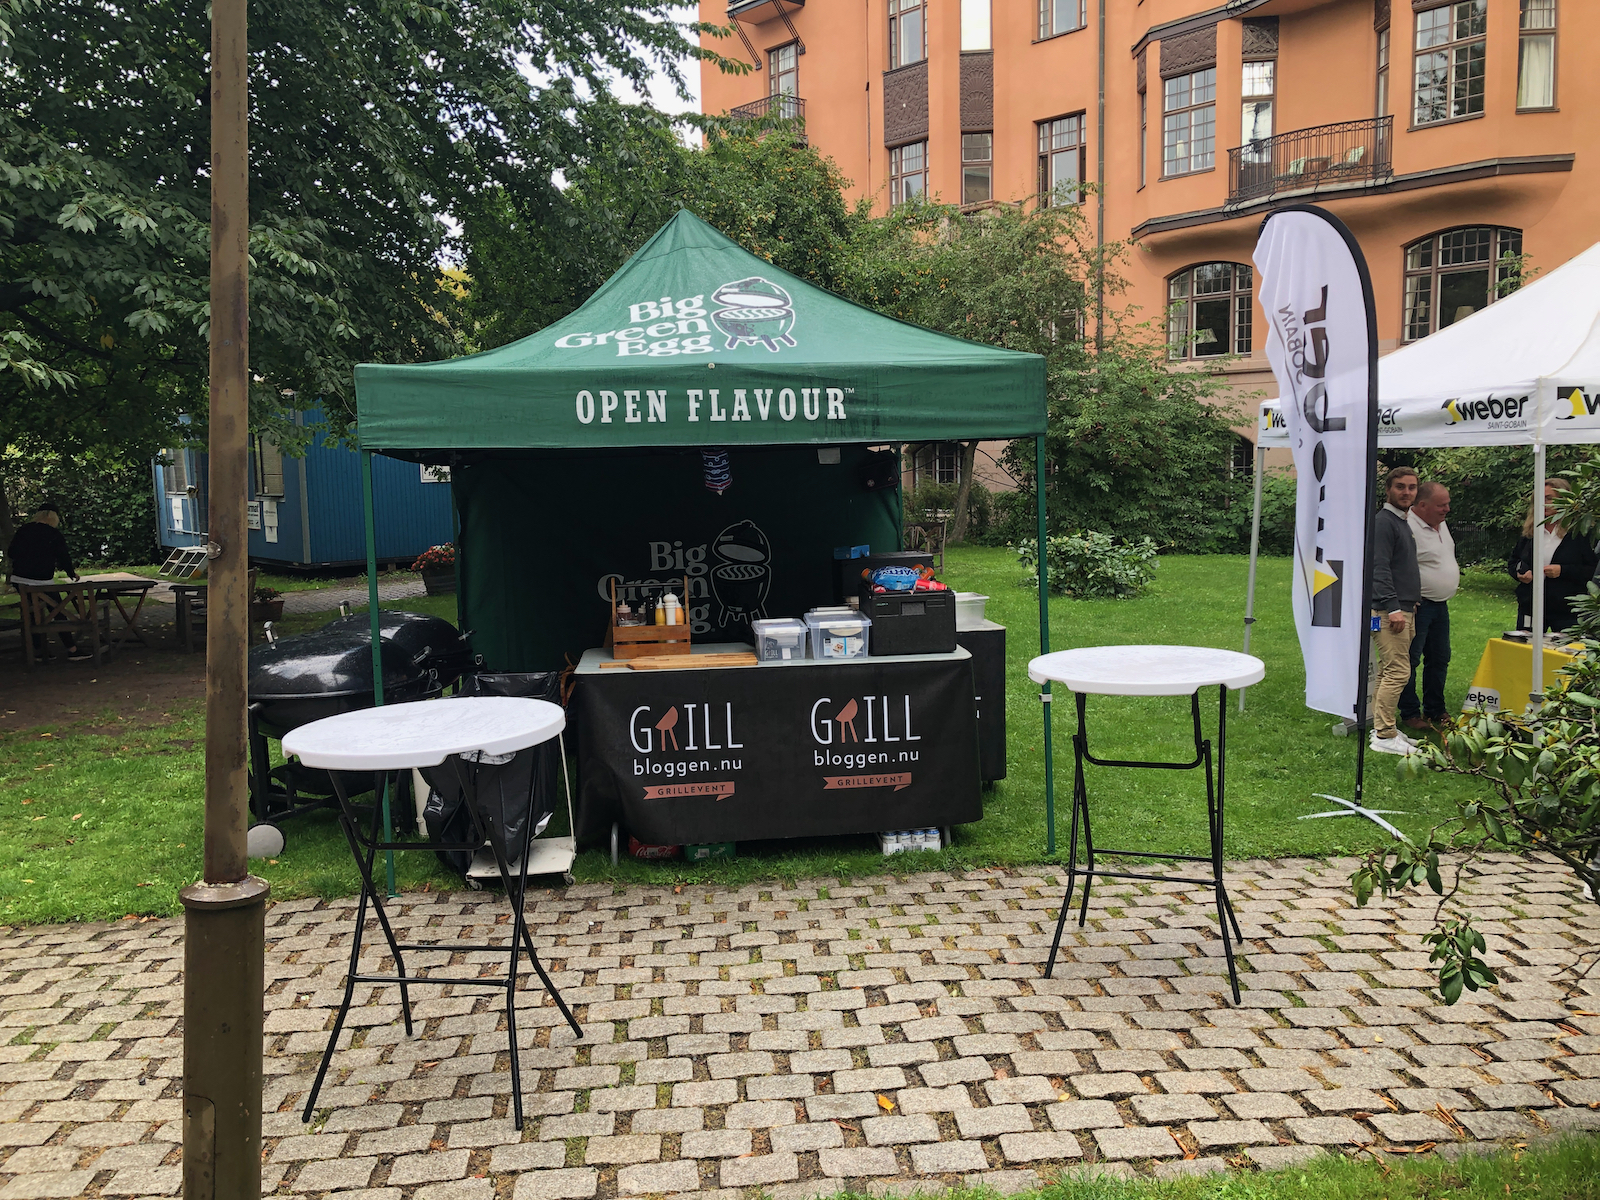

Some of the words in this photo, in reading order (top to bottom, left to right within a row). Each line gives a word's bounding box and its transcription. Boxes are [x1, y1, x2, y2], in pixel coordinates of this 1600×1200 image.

[628, 294, 707, 323] Big
[554, 317, 713, 348] Green
[616, 334, 712, 357] Egg
[575, 389, 667, 424] OPEN
[686, 388, 847, 422] FLAVOUR
[1455, 392, 1529, 421] weber
[1487, 420, 1527, 430] SAINT-GOBAIN
[648, 540, 709, 576] Big
[630, 701, 744, 754] GRILL
[810, 694, 922, 745] GRILL
[633, 756, 743, 777] bloggen.nu
[814, 748, 919, 769] bloggen.nu
[657, 784, 726, 796] GRILLEVENT
[837, 776, 904, 787] GRILLEVENT
